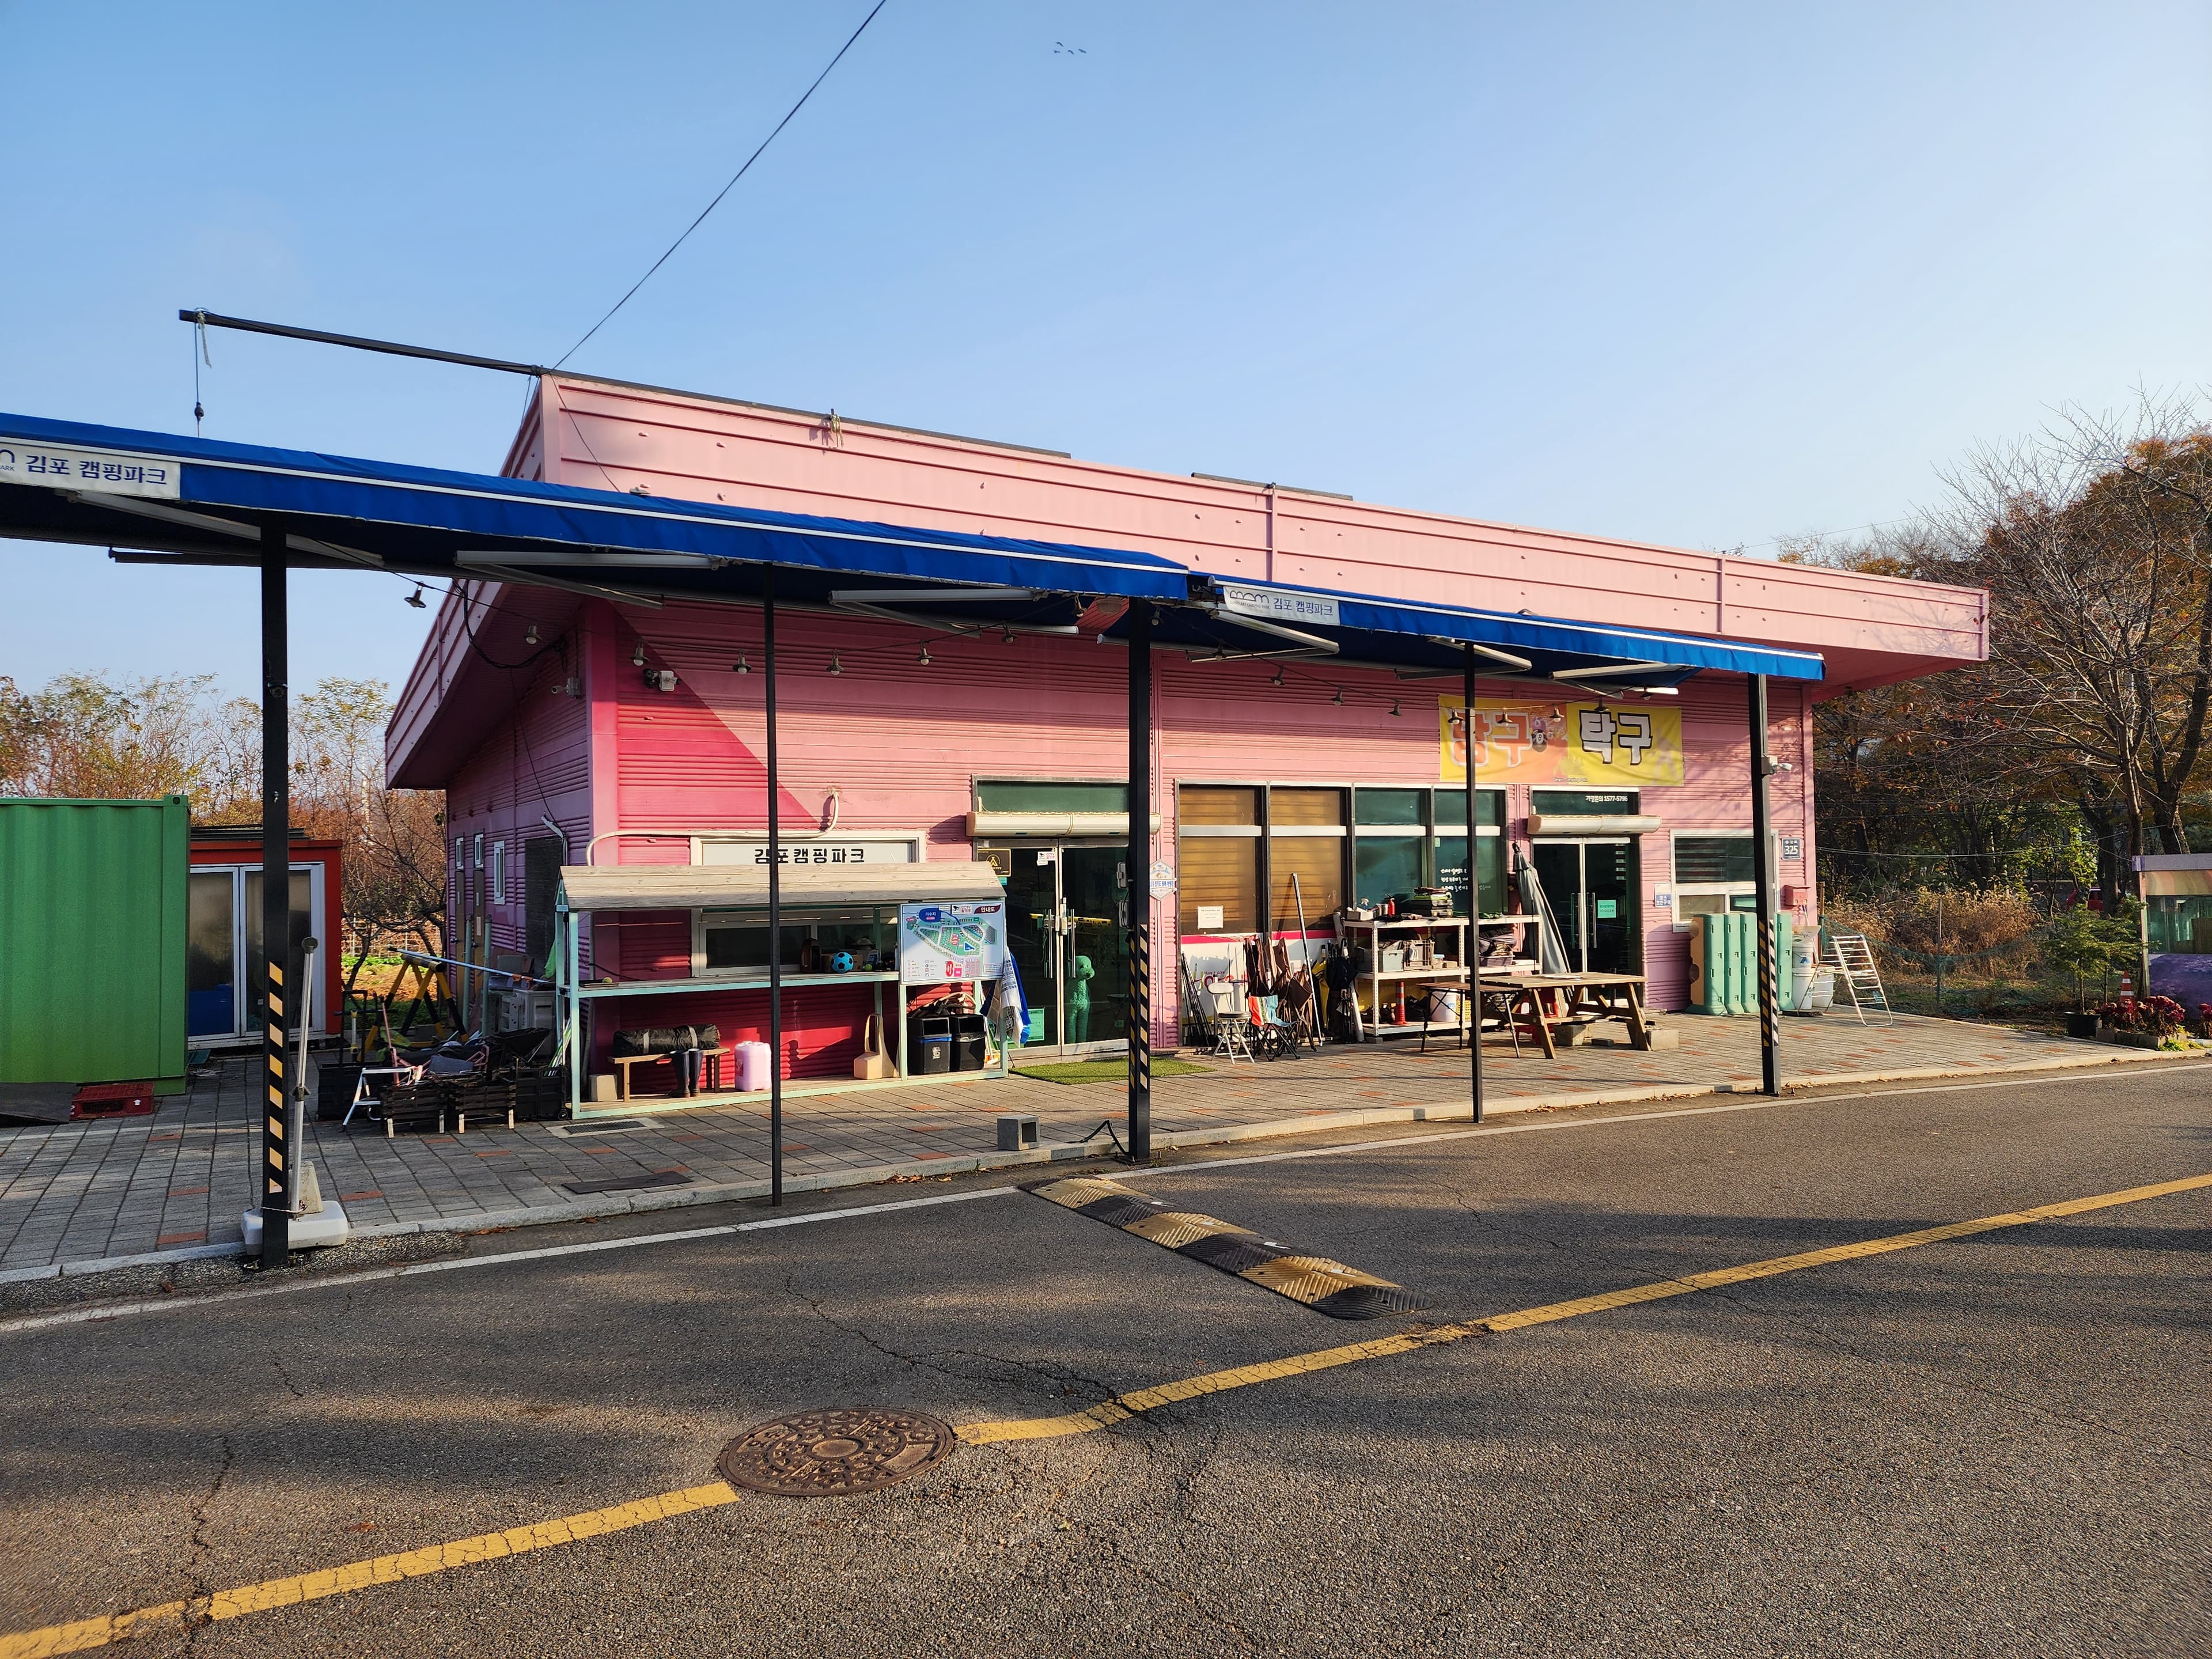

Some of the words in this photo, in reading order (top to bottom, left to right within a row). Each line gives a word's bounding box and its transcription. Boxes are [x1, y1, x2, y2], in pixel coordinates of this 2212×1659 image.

[26, 454, 70, 475] 김포
[79, 460, 167, 485] 캠핑파크
[1273, 597, 1293, 611] 김포
[1296, 600, 1333, 616] 캠핑파크
[1450, 710, 1532, 767] 당구
[1580, 709, 1653, 765] 탁구
[755, 849, 865, 863] 김포캠핑파크
[1785, 845, 1798, 854] 325
